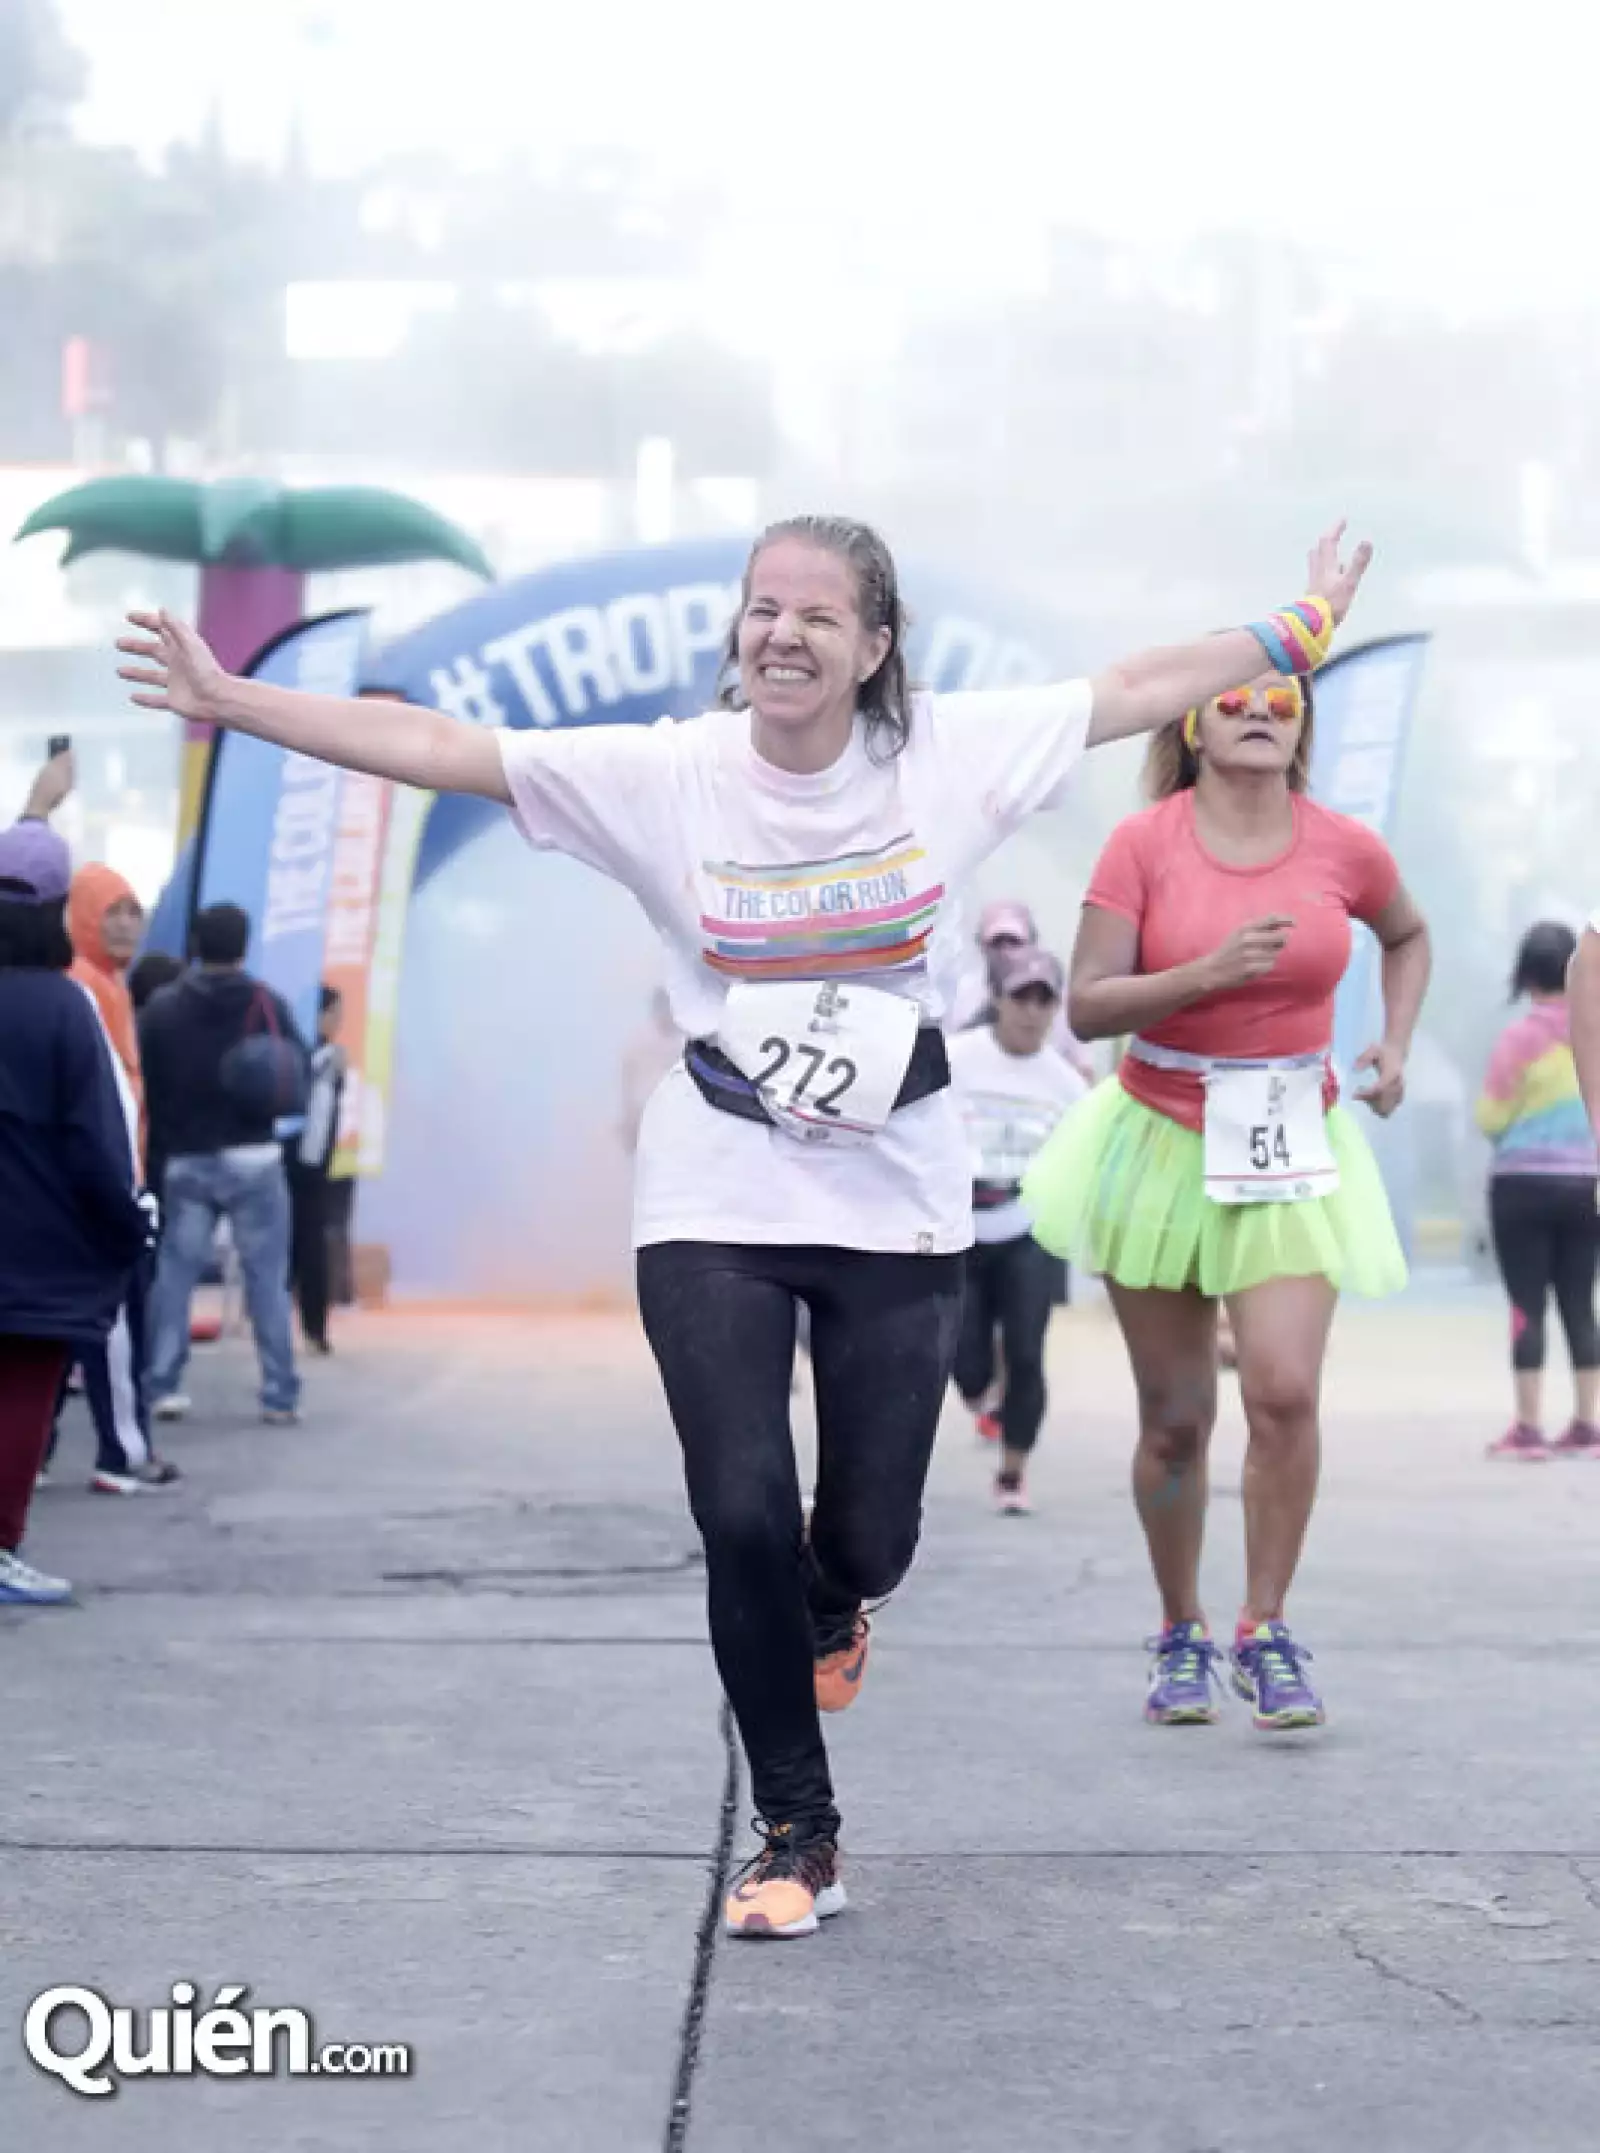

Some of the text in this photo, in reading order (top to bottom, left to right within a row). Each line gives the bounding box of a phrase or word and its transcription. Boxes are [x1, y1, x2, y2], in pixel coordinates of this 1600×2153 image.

[430, 580, 746, 727] #TROP
[724, 886, 766, 919] THE
[770, 881, 853, 918] COLOR
[752, 1036, 858, 1117] 272
[1249, 1124, 1292, 1169] 54
